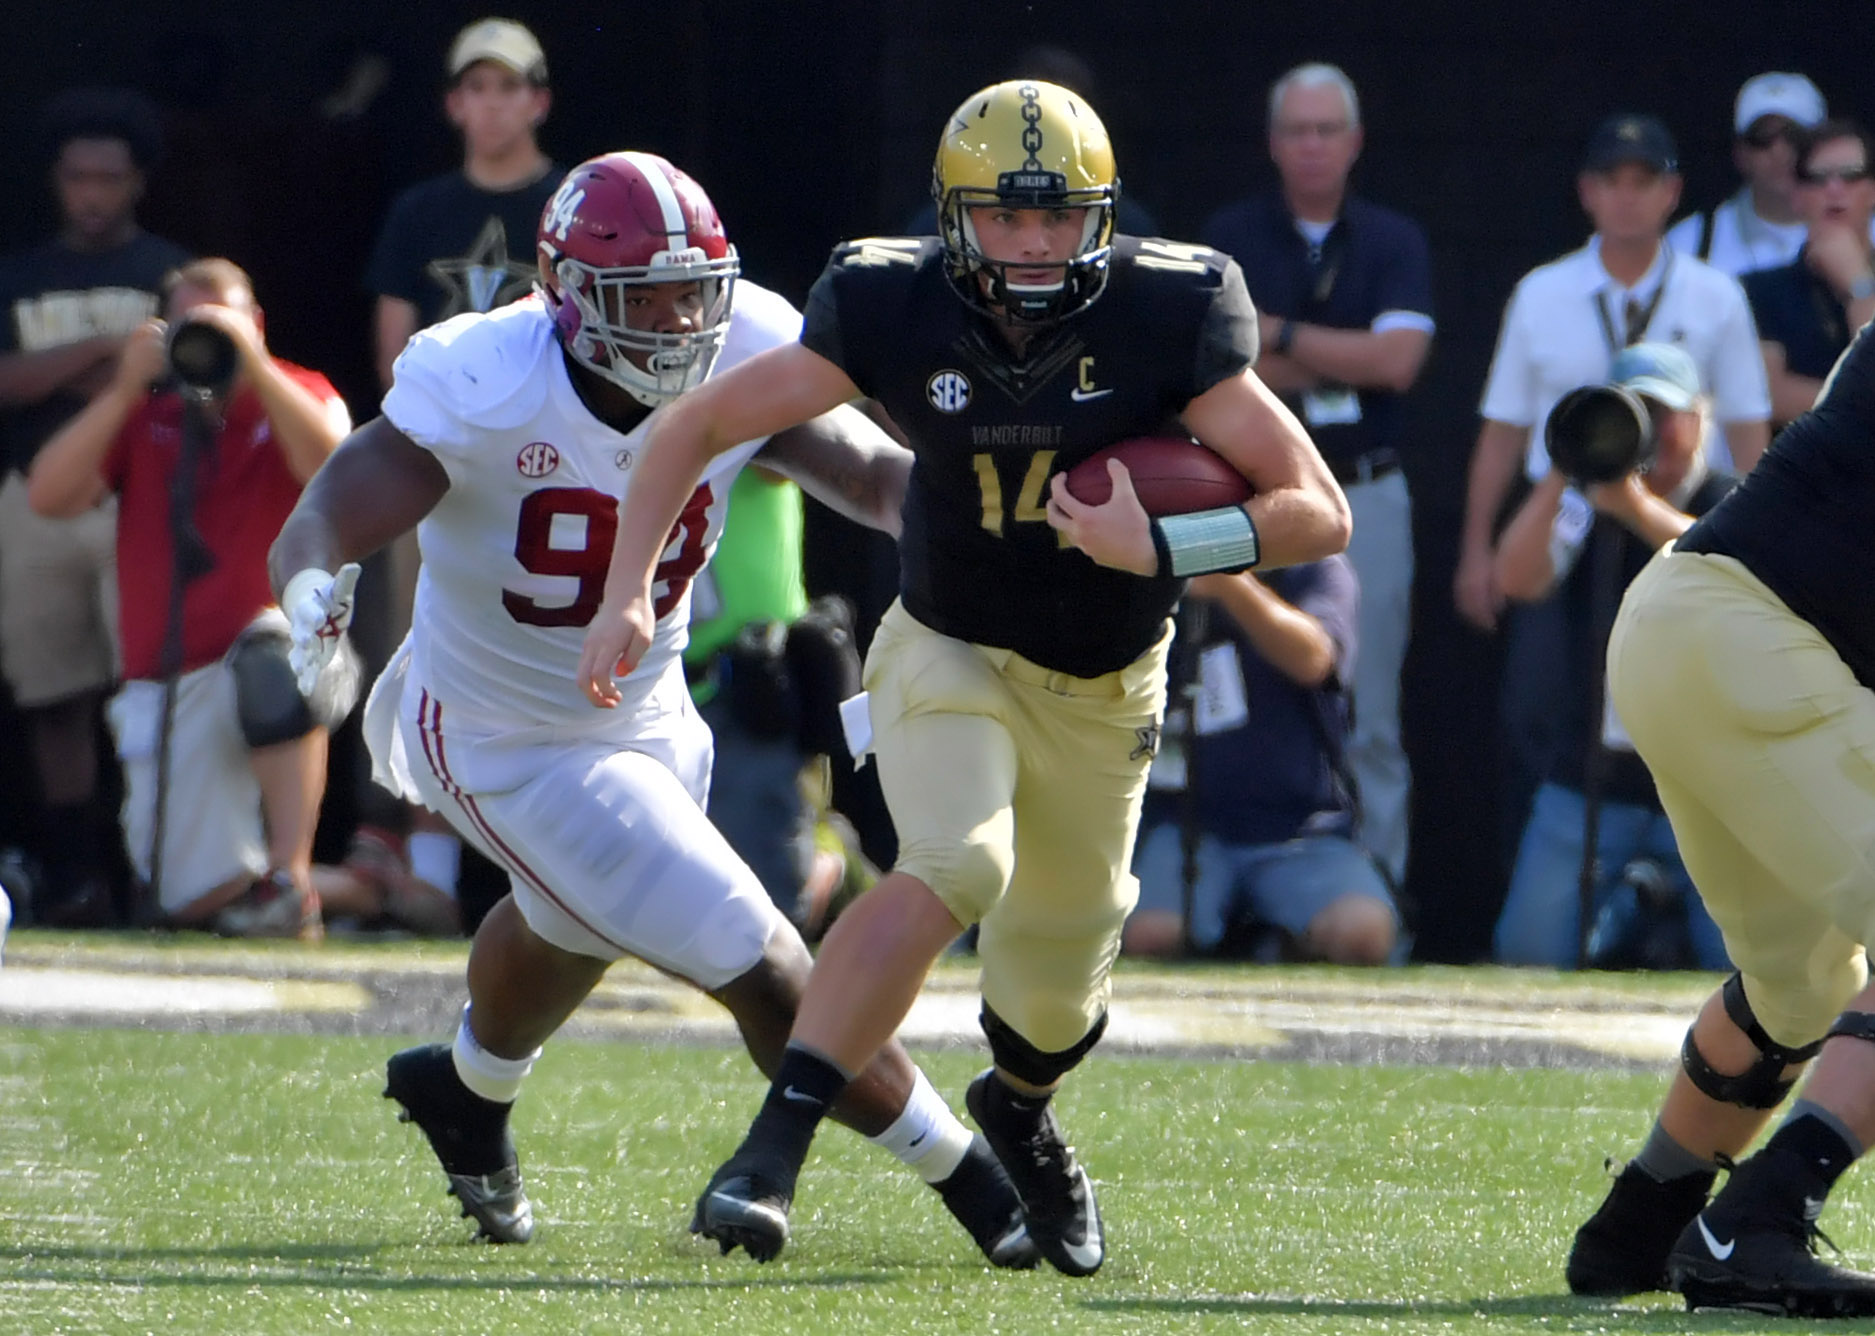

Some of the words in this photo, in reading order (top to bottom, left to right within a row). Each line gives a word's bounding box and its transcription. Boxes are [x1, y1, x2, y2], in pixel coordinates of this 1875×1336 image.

[543, 180, 585, 241] 94
[930, 371, 969, 411] SEC
[1080, 356, 1095, 391] C
[972, 425, 1063, 444] VANDERBILT
[519, 443, 557, 476] SEC
[502, 480, 714, 627] 94
